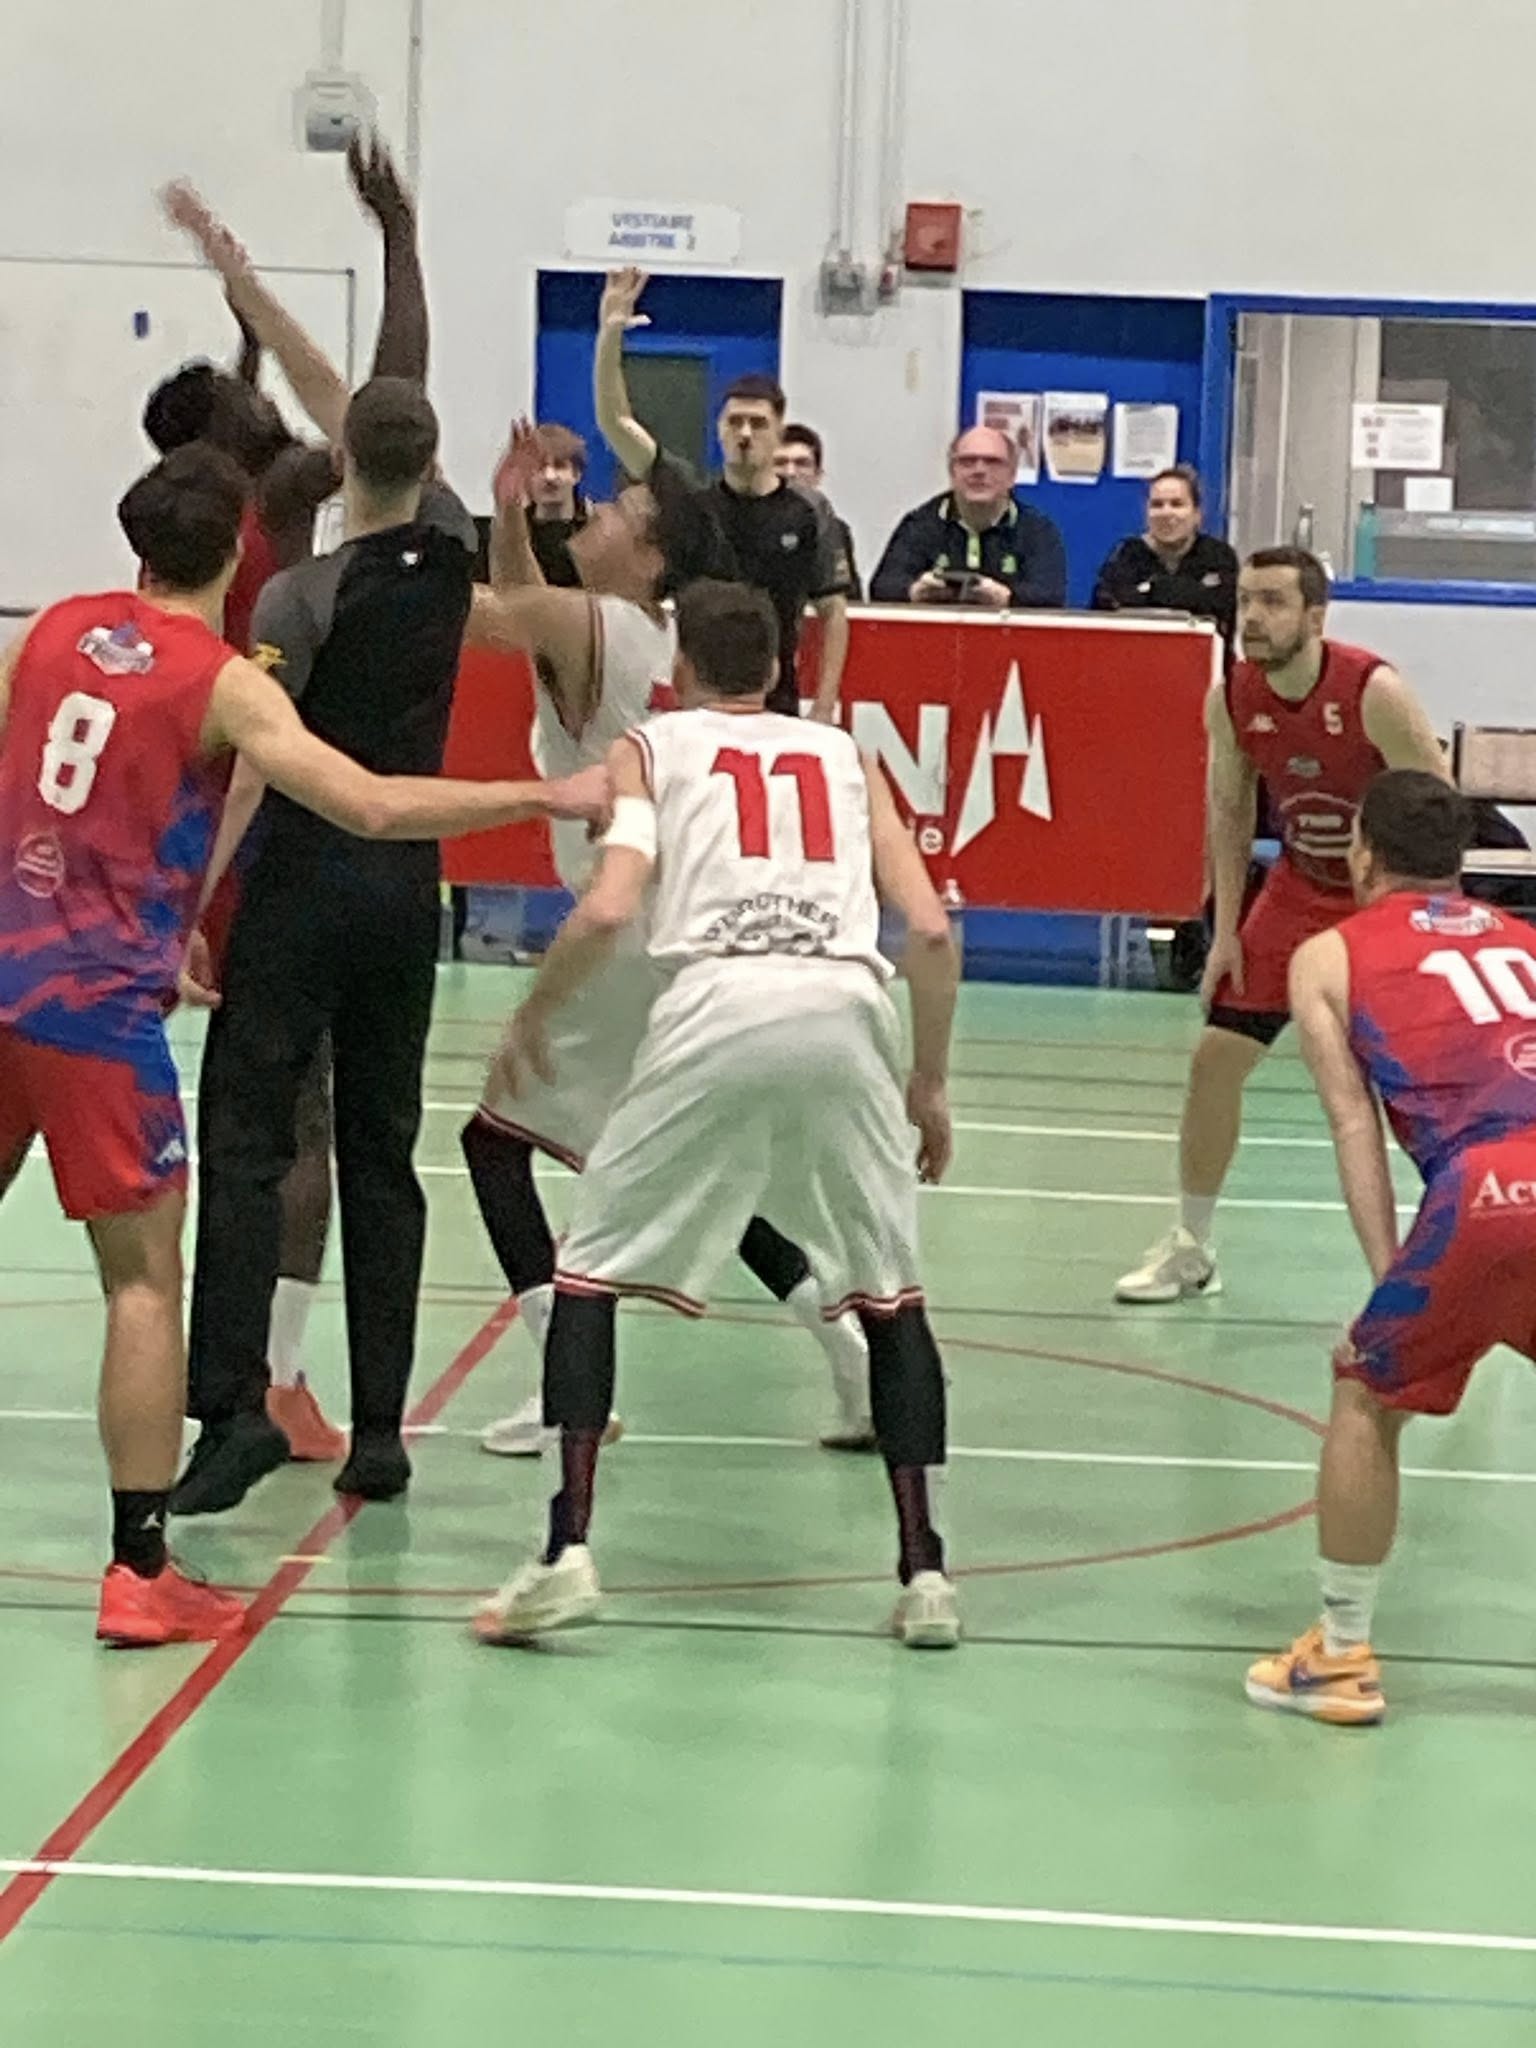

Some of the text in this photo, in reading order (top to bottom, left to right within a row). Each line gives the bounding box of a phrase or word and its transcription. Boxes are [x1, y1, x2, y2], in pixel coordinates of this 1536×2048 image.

[38, 690, 118, 815] 8
[1322, 702, 1344, 736] 5
[709, 746, 836, 863] 11
[1417, 946, 1536, 1026] 10
[1469, 1168, 1536, 1208] Ac
